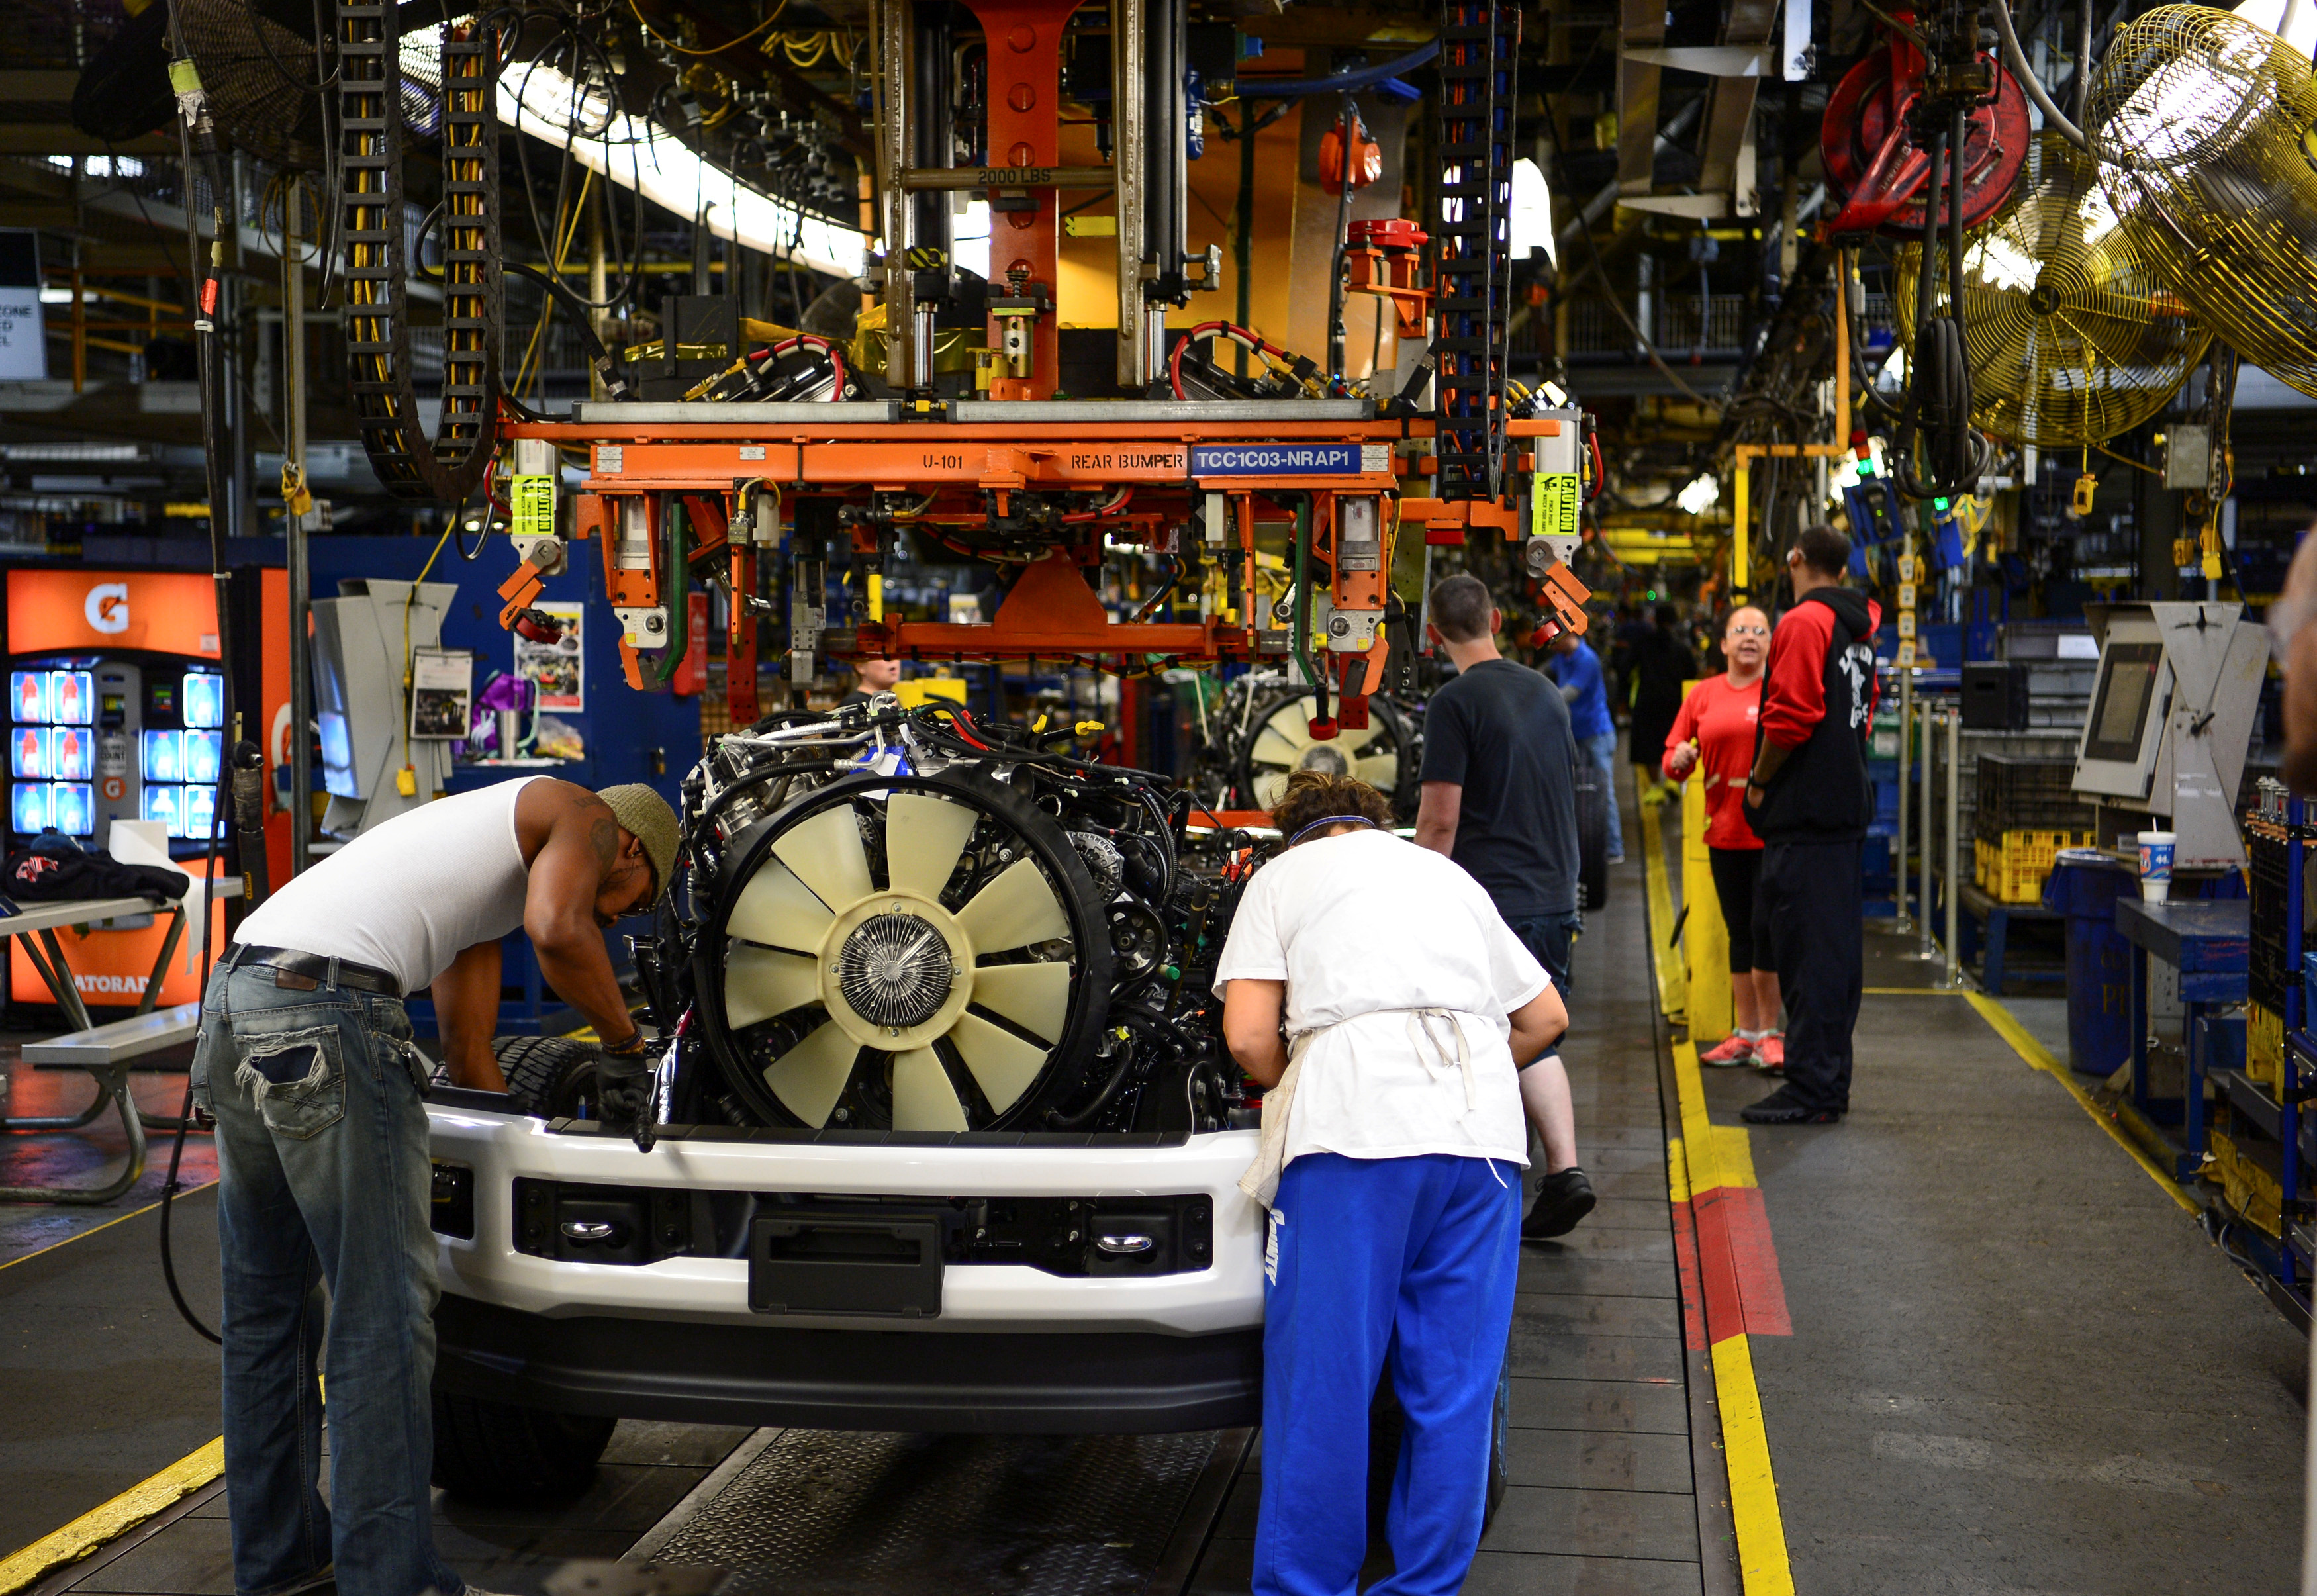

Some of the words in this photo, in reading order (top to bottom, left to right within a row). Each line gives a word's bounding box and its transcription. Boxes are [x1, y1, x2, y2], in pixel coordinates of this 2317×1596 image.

[978, 170, 1016, 185] 2000
[1021, 169, 1051, 183] LBS
[923, 455, 962, 469] U-101
[1072, 455, 1112, 469] REAR
[1119, 454, 1183, 468] BUMPER
[1197, 451, 1348, 468] TCC1C03-NRAP1
[538, 480, 551, 530] CAUTION
[1560, 478, 1575, 530] CAUTION
[84, 582, 130, 634] G
